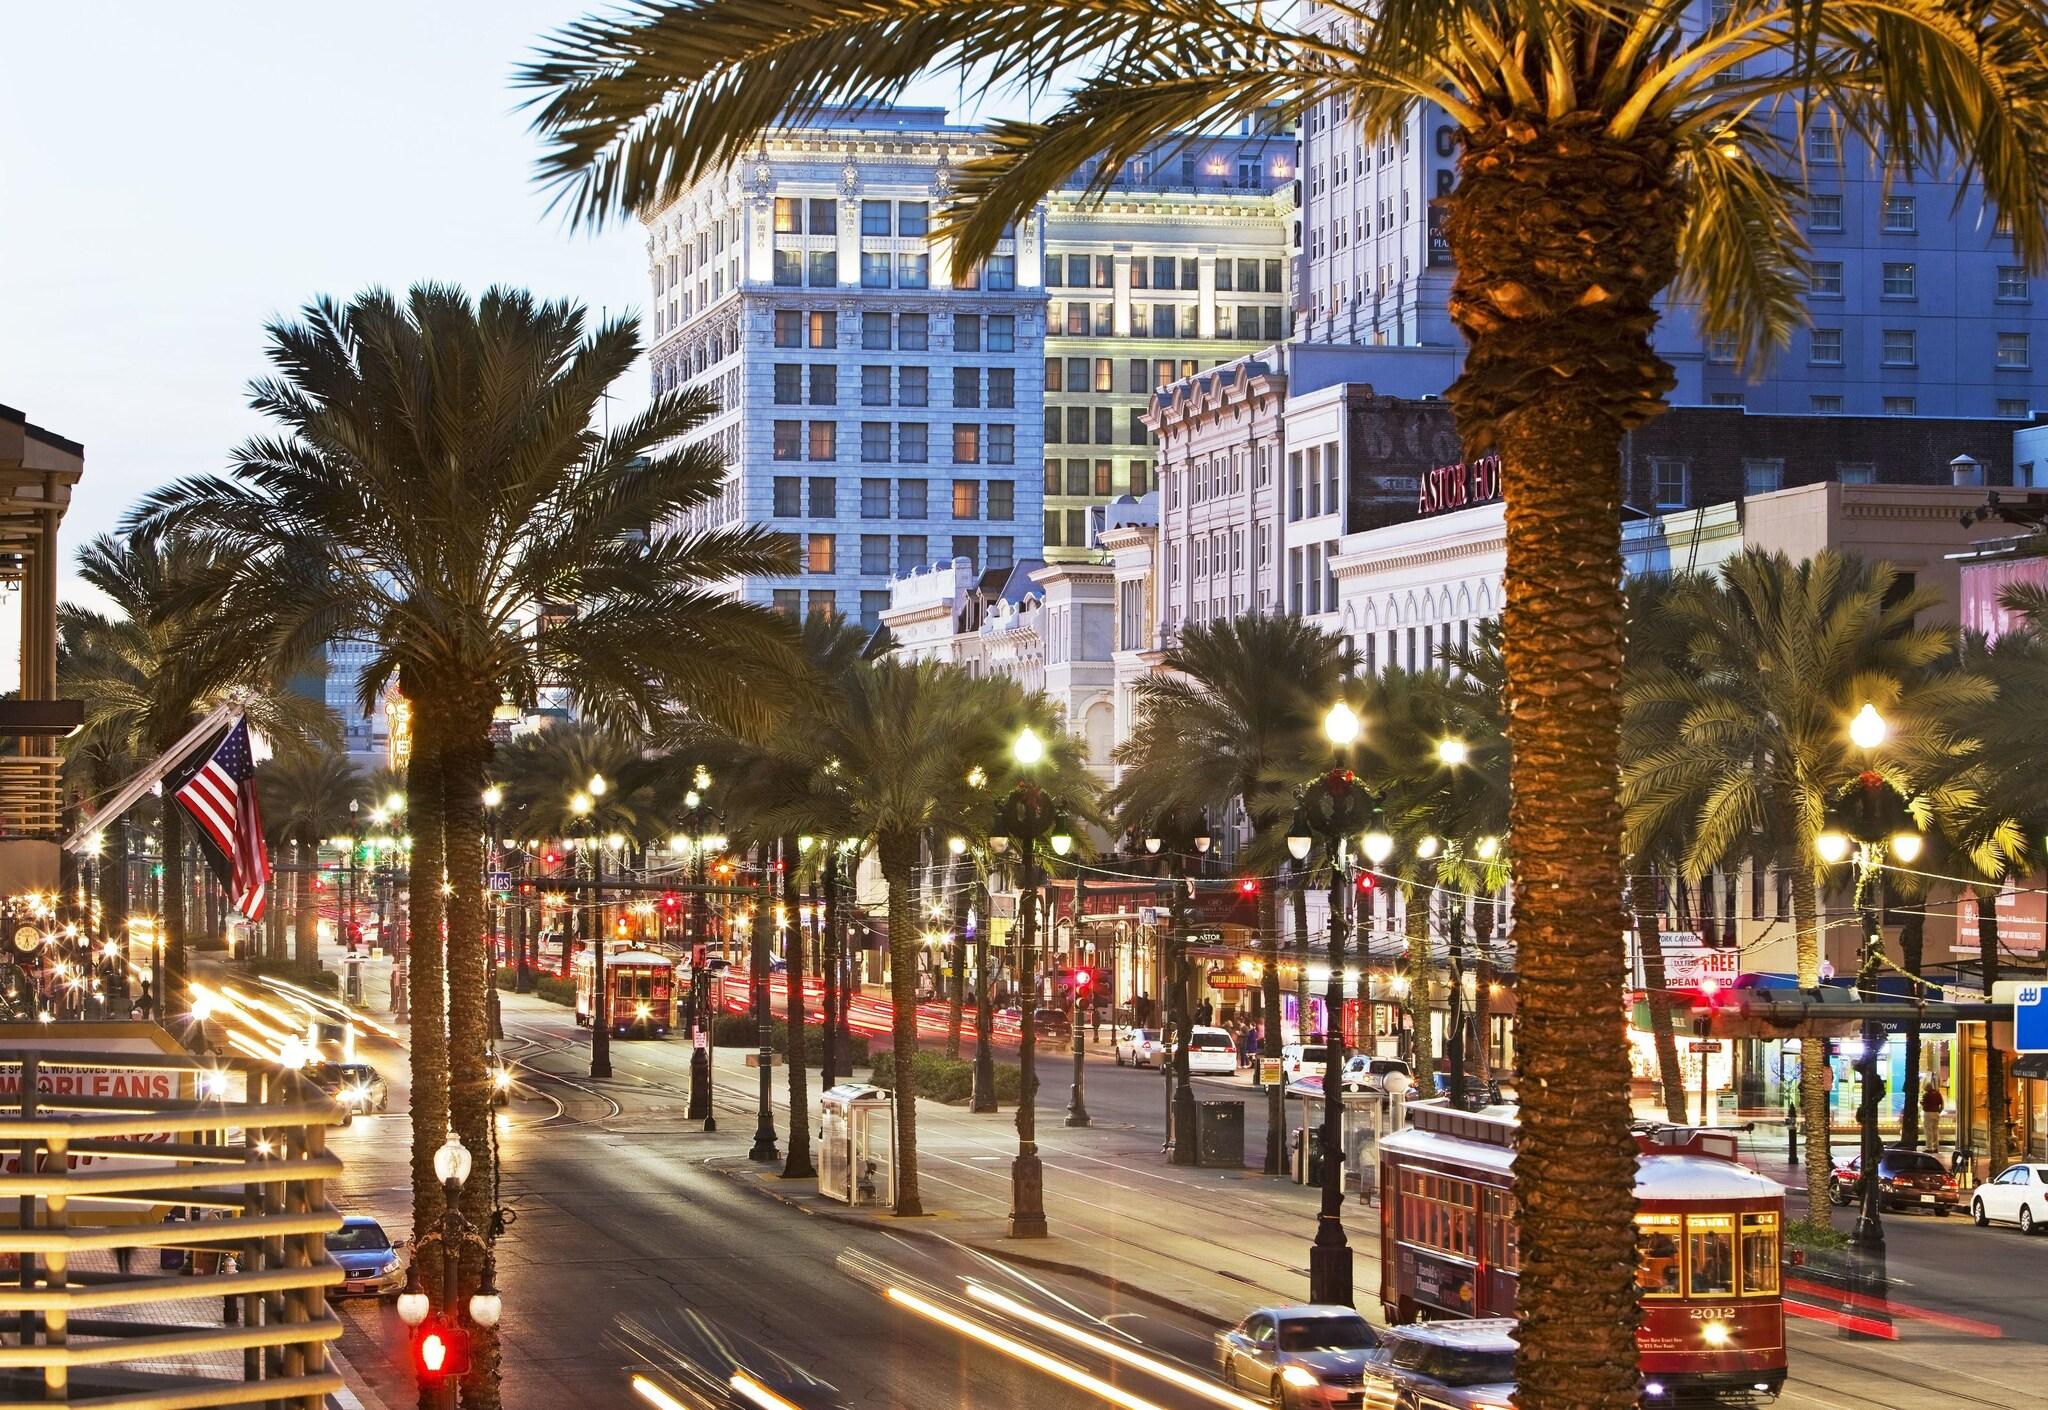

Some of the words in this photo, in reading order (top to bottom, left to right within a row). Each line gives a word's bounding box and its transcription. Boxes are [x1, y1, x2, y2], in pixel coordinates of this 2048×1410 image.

[1418, 462, 1467, 513] ASTOR
[1919, 1022, 1941, 1030] MAPS
[38, 1075, 170, 1100] ORLEANS
[1690, 1308, 1735, 1319] 2012
